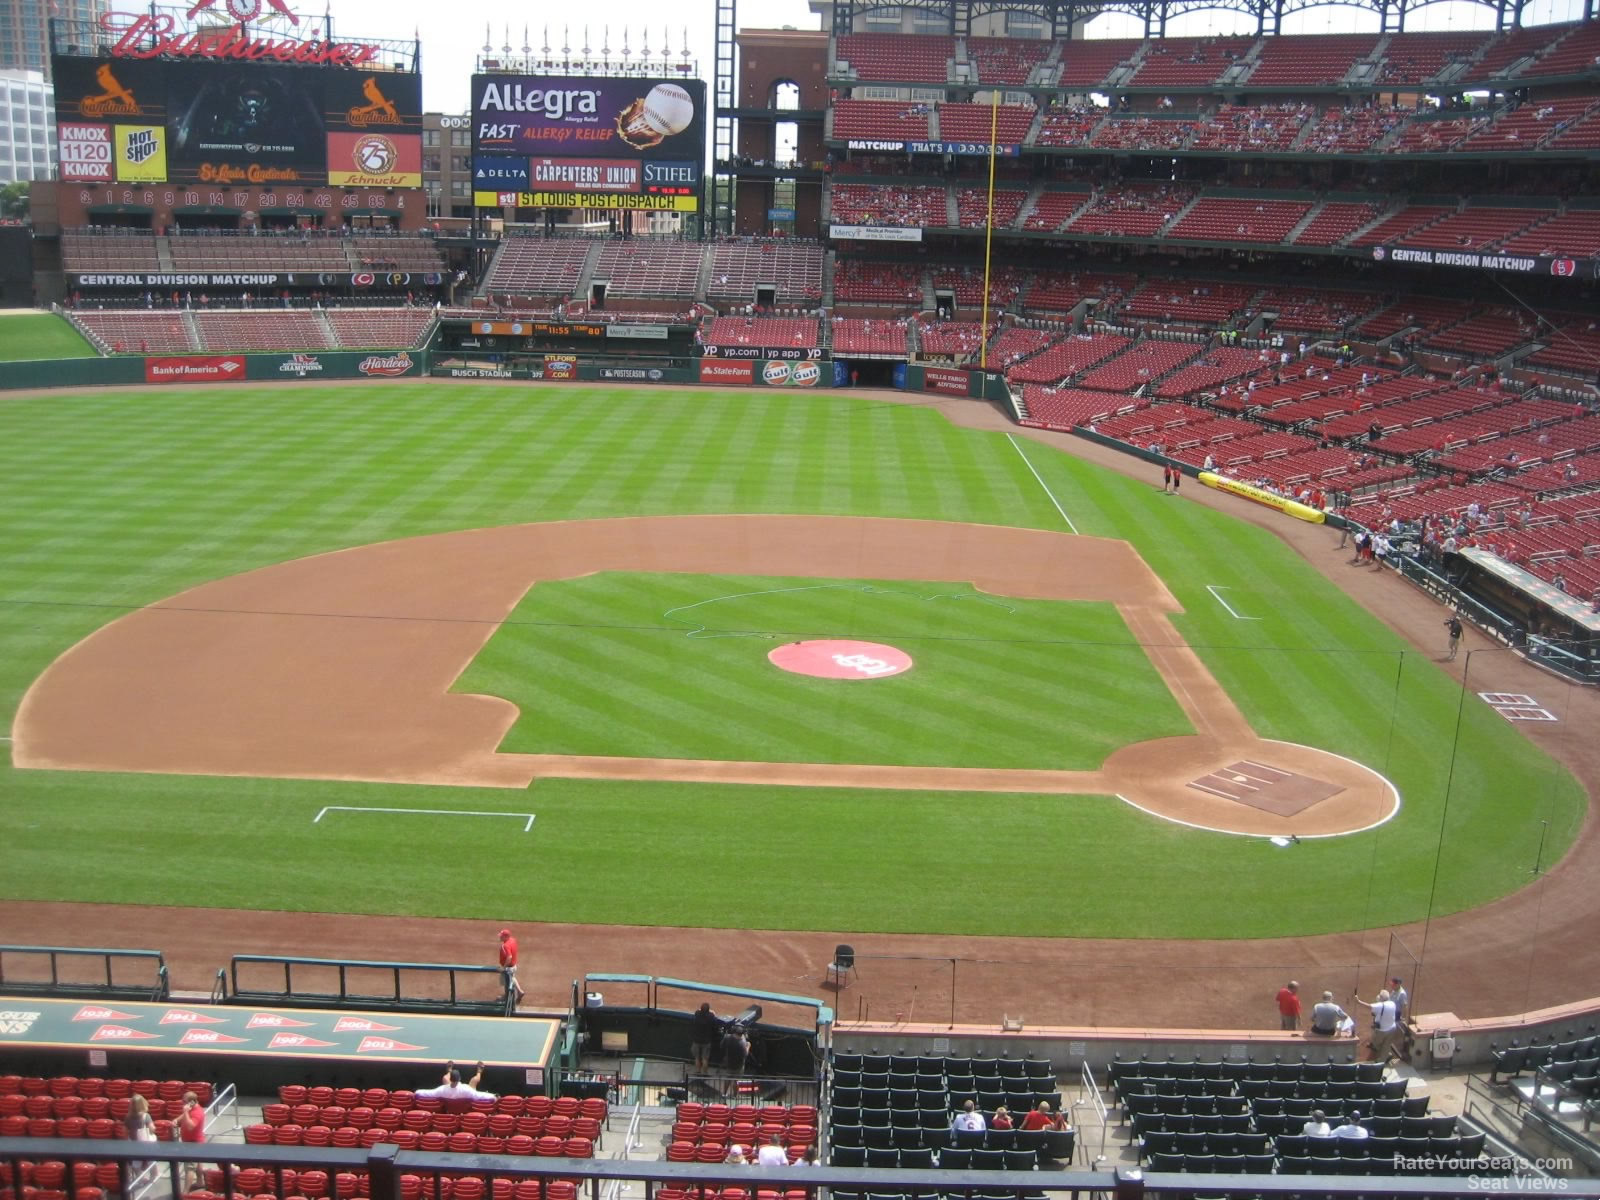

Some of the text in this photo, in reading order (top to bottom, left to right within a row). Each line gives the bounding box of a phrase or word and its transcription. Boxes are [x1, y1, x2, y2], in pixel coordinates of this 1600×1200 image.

[101, 11, 381, 64] Budweiser
[498, 57, 678, 73] WORLD CHAMPIONS
[480, 82, 597, 119] Allegra
[62, 127, 107, 141] KMOX
[479, 123, 614, 142] FAST ALLERGY RELIEF
[128, 130, 153, 147] HOT
[848, 141, 904, 150] MATCHUP
[912, 143, 943, 153] THAT'S
[947, 144, 954, 153] A
[64, 144, 108, 160] 1120
[127, 141, 158, 162] SHOT
[360, 144, 388, 169] 75
[65, 163, 109, 177] KMOX
[247, 163, 298, 183] Cardinals
[488, 169, 527, 178] DELTA
[536, 165, 637, 184] CARPENTERS' UNION
[644, 164, 696, 182] STIFEL
[344, 175, 407, 185] Schnucks
[106, 190, 386, 208] 1 2 6 9 10 14 17 20 24 42 45 85
[522, 192, 675, 209] ST. LOUIS POST-DISPATCH
[834, 228, 856, 238] Mercy
[1391, 249, 1535, 271] CENTRAL DIVISION MATCHUP
[79, 275, 278, 285] CENTRAL DIVISION MATCHUP
[549, 327, 569, 335] 11:55
[609, 328, 627, 336] Mercy
[703, 345, 718, 356] yp
[724, 347, 801, 358] yp.com yp app
[807, 348, 822, 359] yp
[153, 365, 219, 375] Bank of America
[280, 363, 323, 371] CHAMPIONS
[451, 369, 512, 378] BUSCH STADIUM
[614, 369, 646, 378] POSTSEASON
[764, 367, 789, 379] Gulf
[793, 368, 819, 380] Gulf
[80, 1009, 113, 1018] 1928
[166, 1012, 198, 1021] 1943
[252, 1016, 282, 1026] 1985
[340, 1020, 372, 1030] 2004
[99, 1028, 133, 1037] 1930
[187, 1032, 220, 1041] 1968
[274, 1036, 305, 1046] 1987
[363, 1040, 394, 1049] 2013
